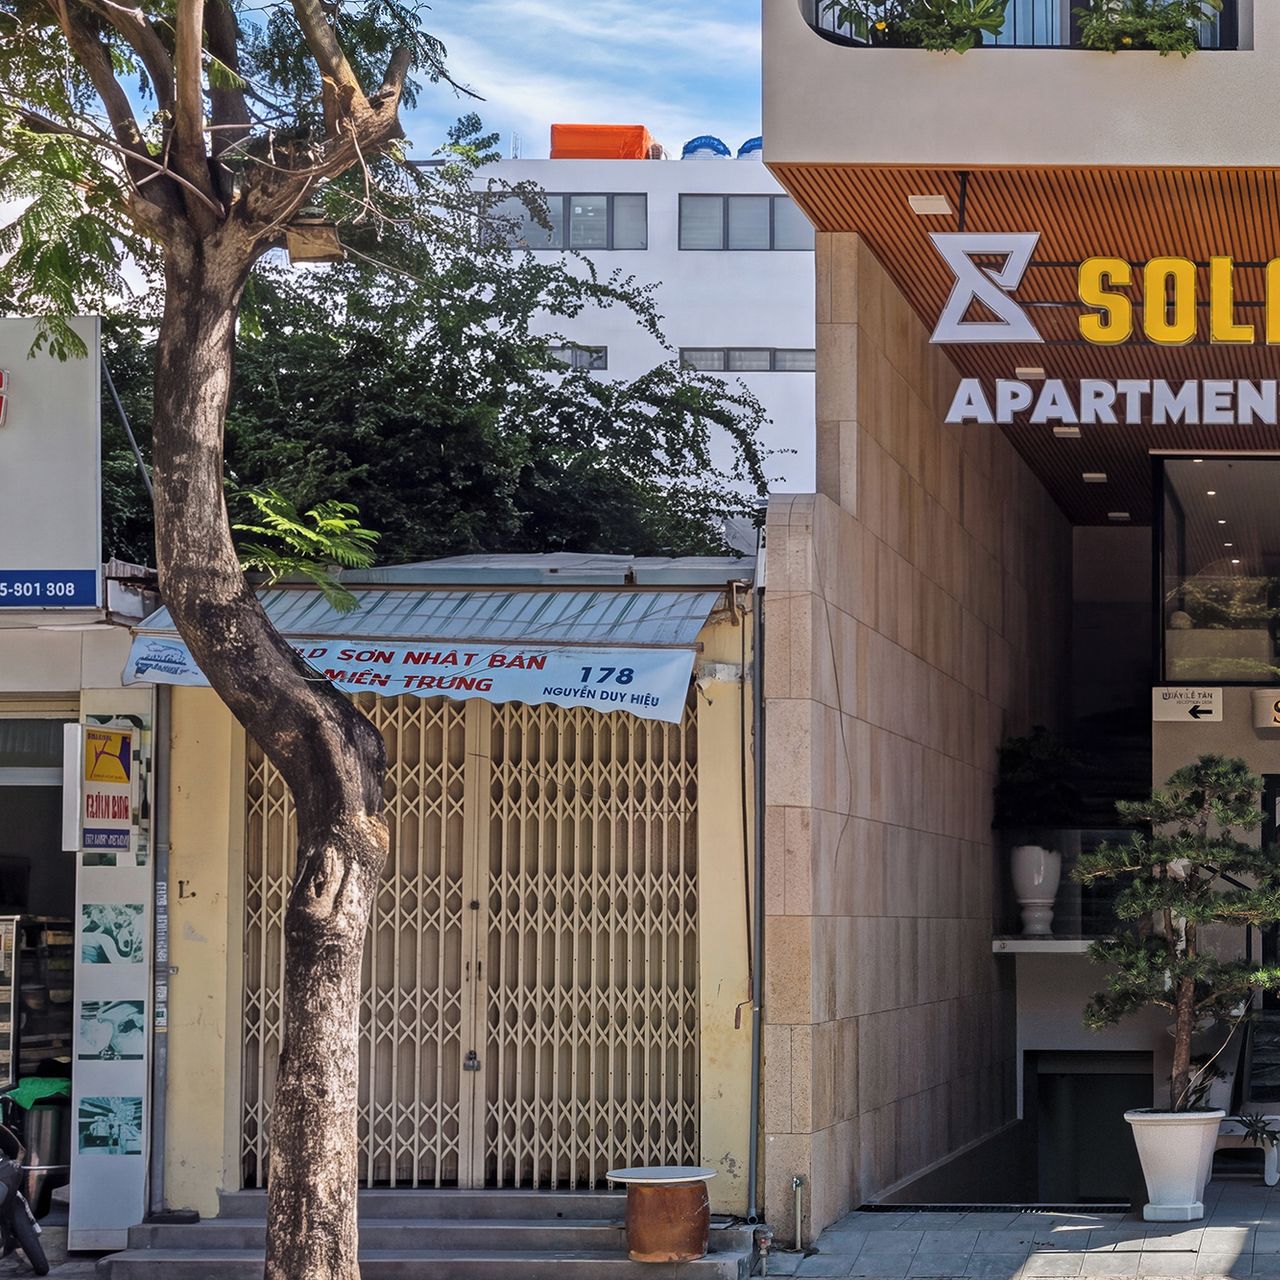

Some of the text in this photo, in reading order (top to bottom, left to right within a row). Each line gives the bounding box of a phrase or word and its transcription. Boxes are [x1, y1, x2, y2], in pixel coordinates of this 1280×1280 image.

[336, 648, 396, 664] SƠN
[402, 649, 479, 668] NHẬT
[487, 651, 547, 670] BẢN
[403, 675, 494, 692] TRUNG
[580, 666, 635, 685] 178
[542, 685, 660, 709] NGUYỄN DUY HIỆU
